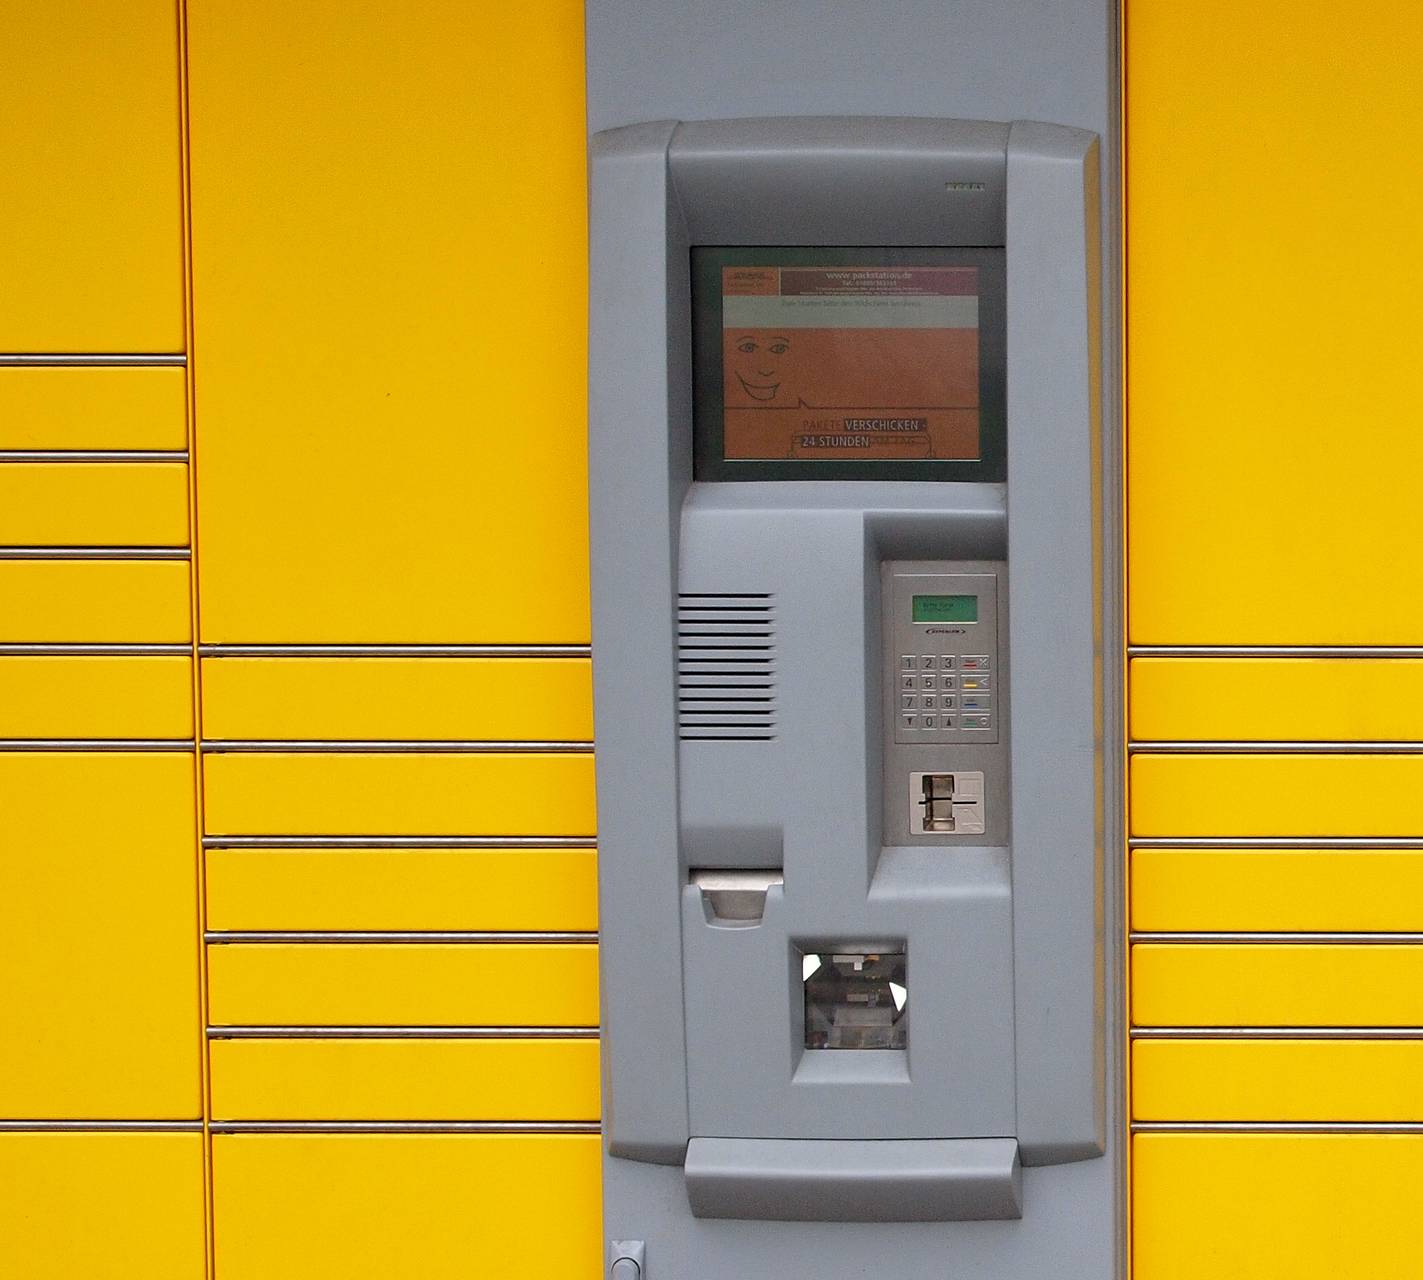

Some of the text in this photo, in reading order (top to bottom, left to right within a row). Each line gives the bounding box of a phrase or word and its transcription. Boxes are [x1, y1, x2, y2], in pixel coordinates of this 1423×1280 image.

[845, 419, 919, 431] VERSCHICKEN
[802, 436, 816, 447] 24
[819, 436, 870, 447] STUNDEN
